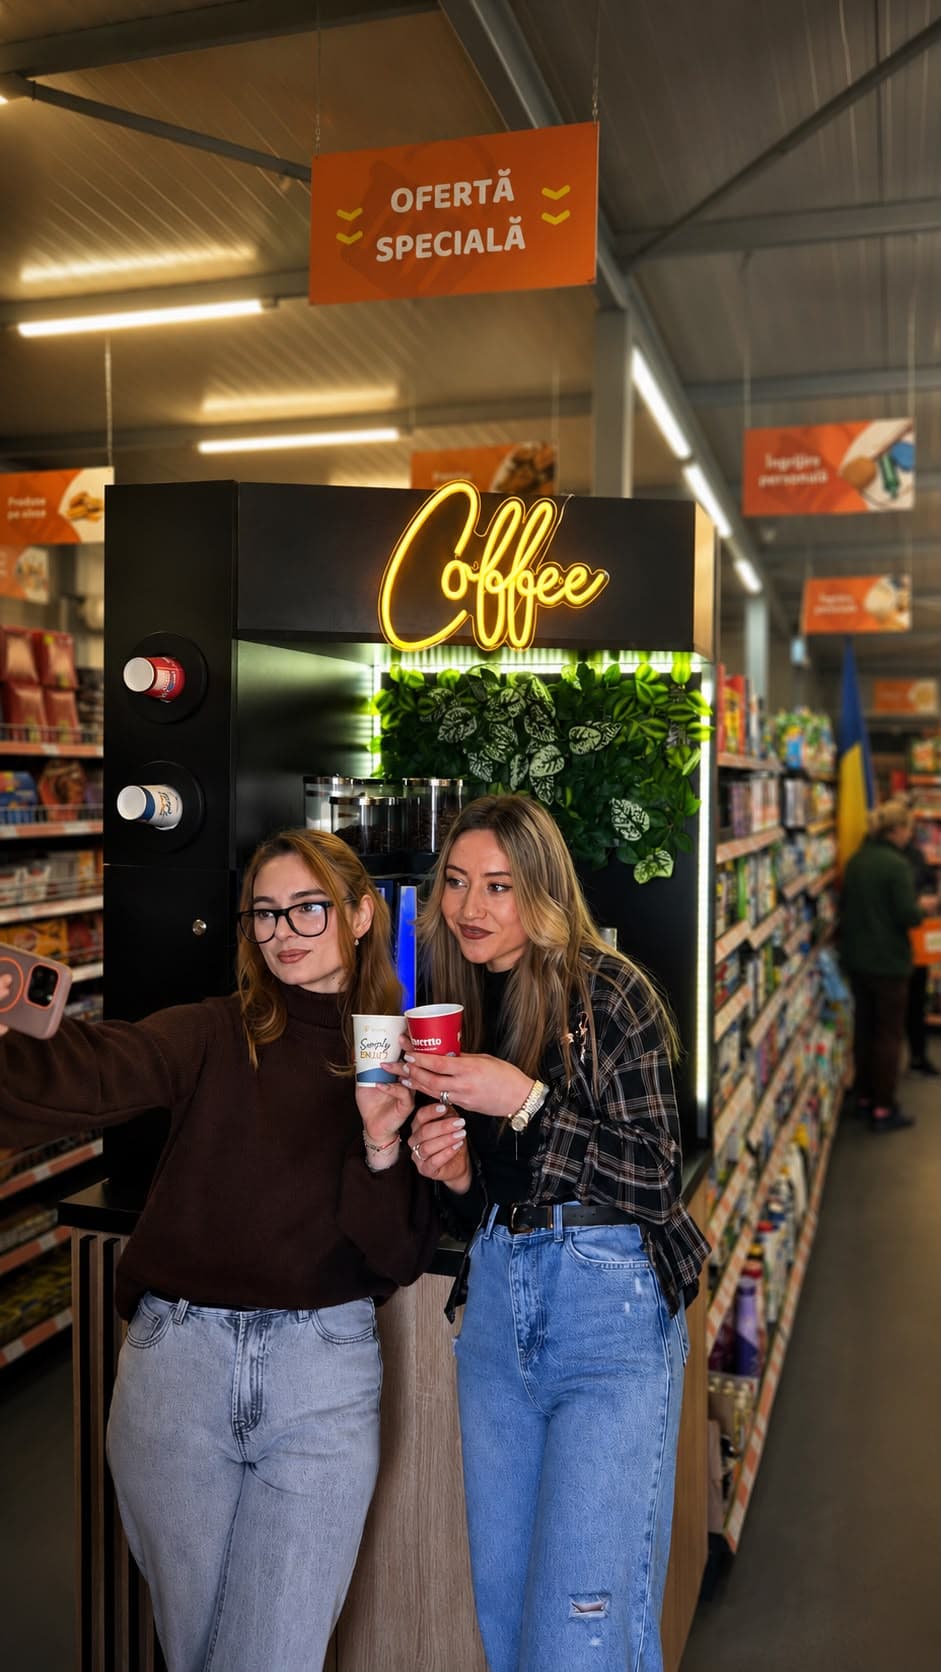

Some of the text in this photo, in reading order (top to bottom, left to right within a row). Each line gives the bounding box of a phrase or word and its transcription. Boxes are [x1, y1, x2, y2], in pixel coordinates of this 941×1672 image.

[390, 168, 515, 214] OFERTĂ
[375, 215, 526, 263] SPECIALĂ
[381, 481, 606, 648] Coffee
